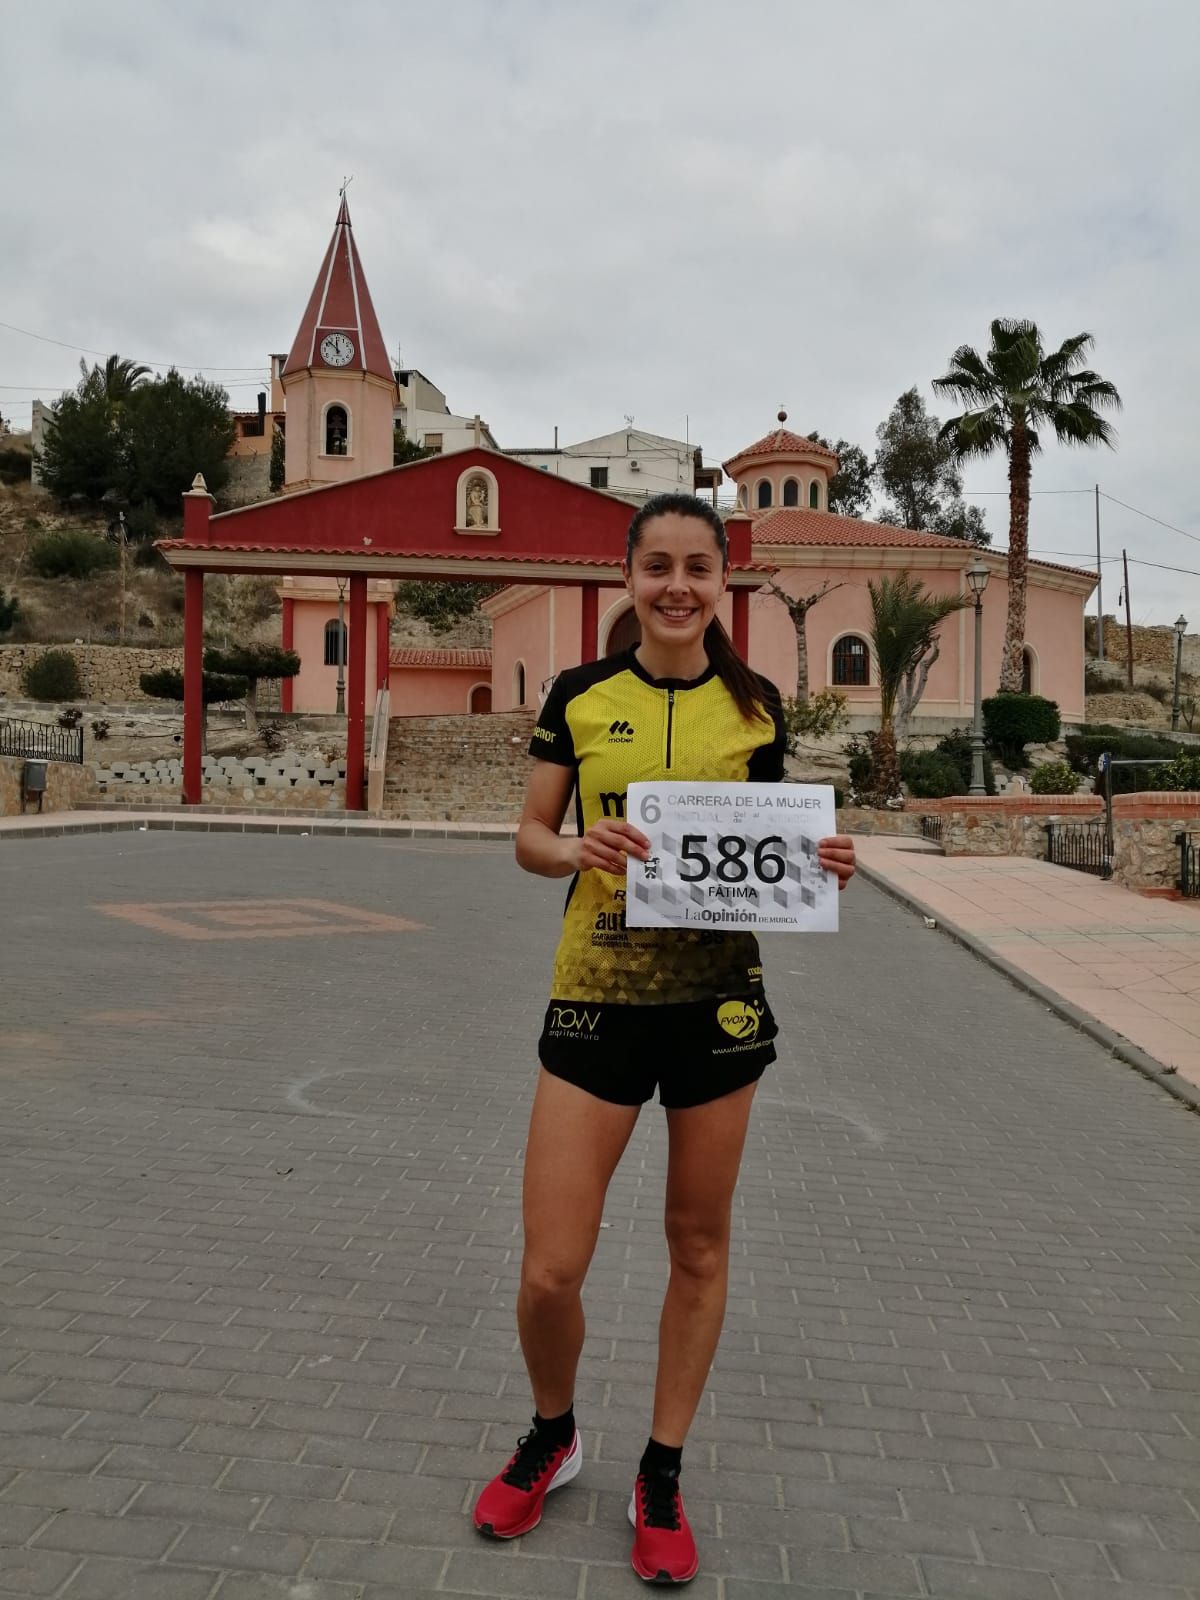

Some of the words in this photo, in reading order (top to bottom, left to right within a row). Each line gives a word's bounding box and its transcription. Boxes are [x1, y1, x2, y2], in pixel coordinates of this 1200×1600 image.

[640, 794, 662, 824] 6
[667, 795, 732, 807] CARRERA
[735, 796, 753, 807] DE
[757, 797, 773, 808] LA
[776, 798, 821, 809] MUJER
[679, 835, 786, 884] 586
[708, 884, 757, 898] FÁTIMA
